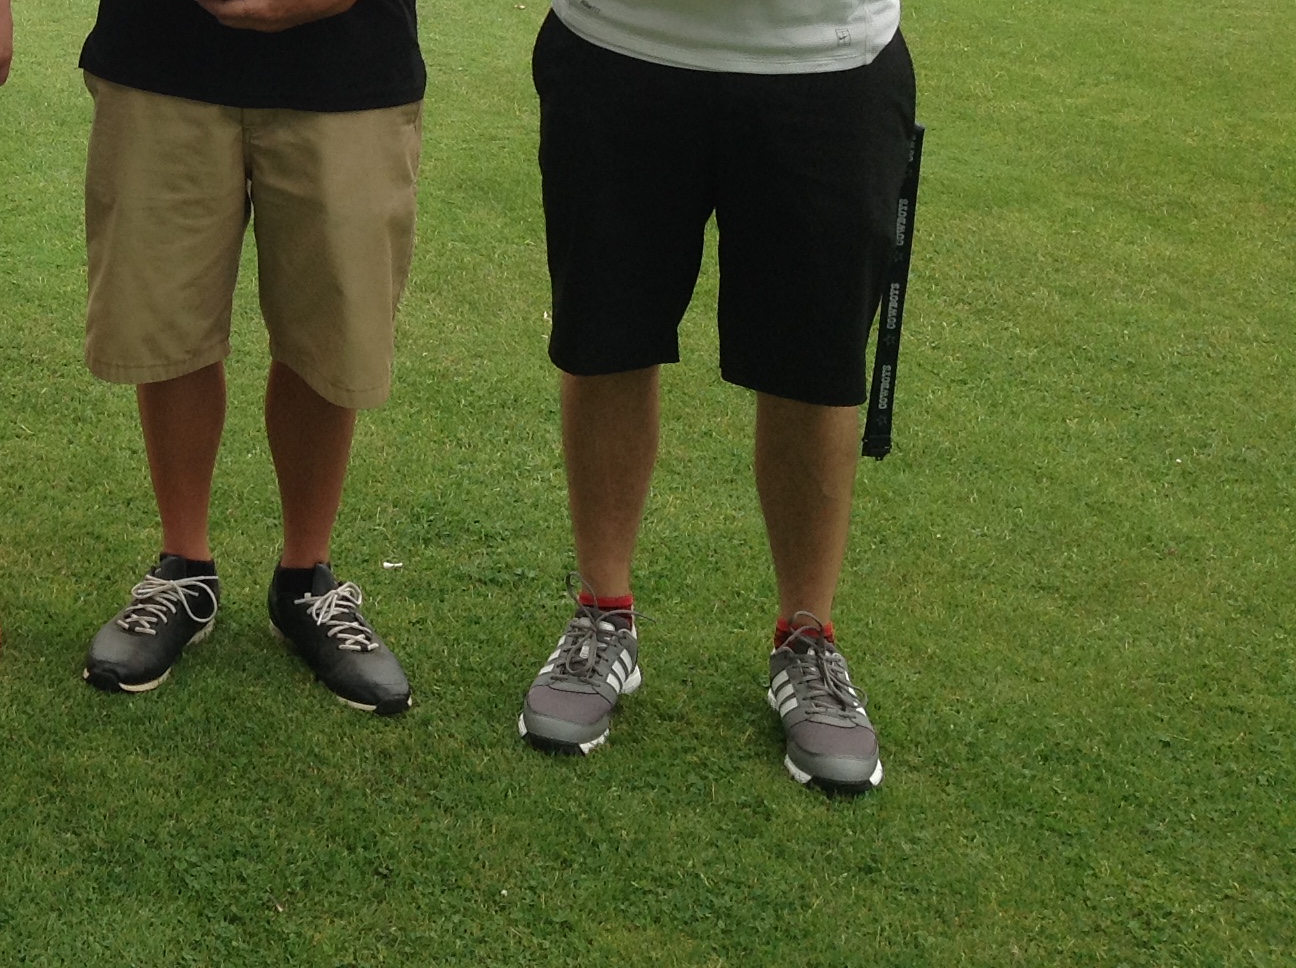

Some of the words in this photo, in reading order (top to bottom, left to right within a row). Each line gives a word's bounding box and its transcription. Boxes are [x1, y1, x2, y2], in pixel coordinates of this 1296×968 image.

[895, 198, 909, 246] COWBOYS
[886, 282, 900, 330] COWBOYS
[878, 364, 892, 410] COWBOYS
